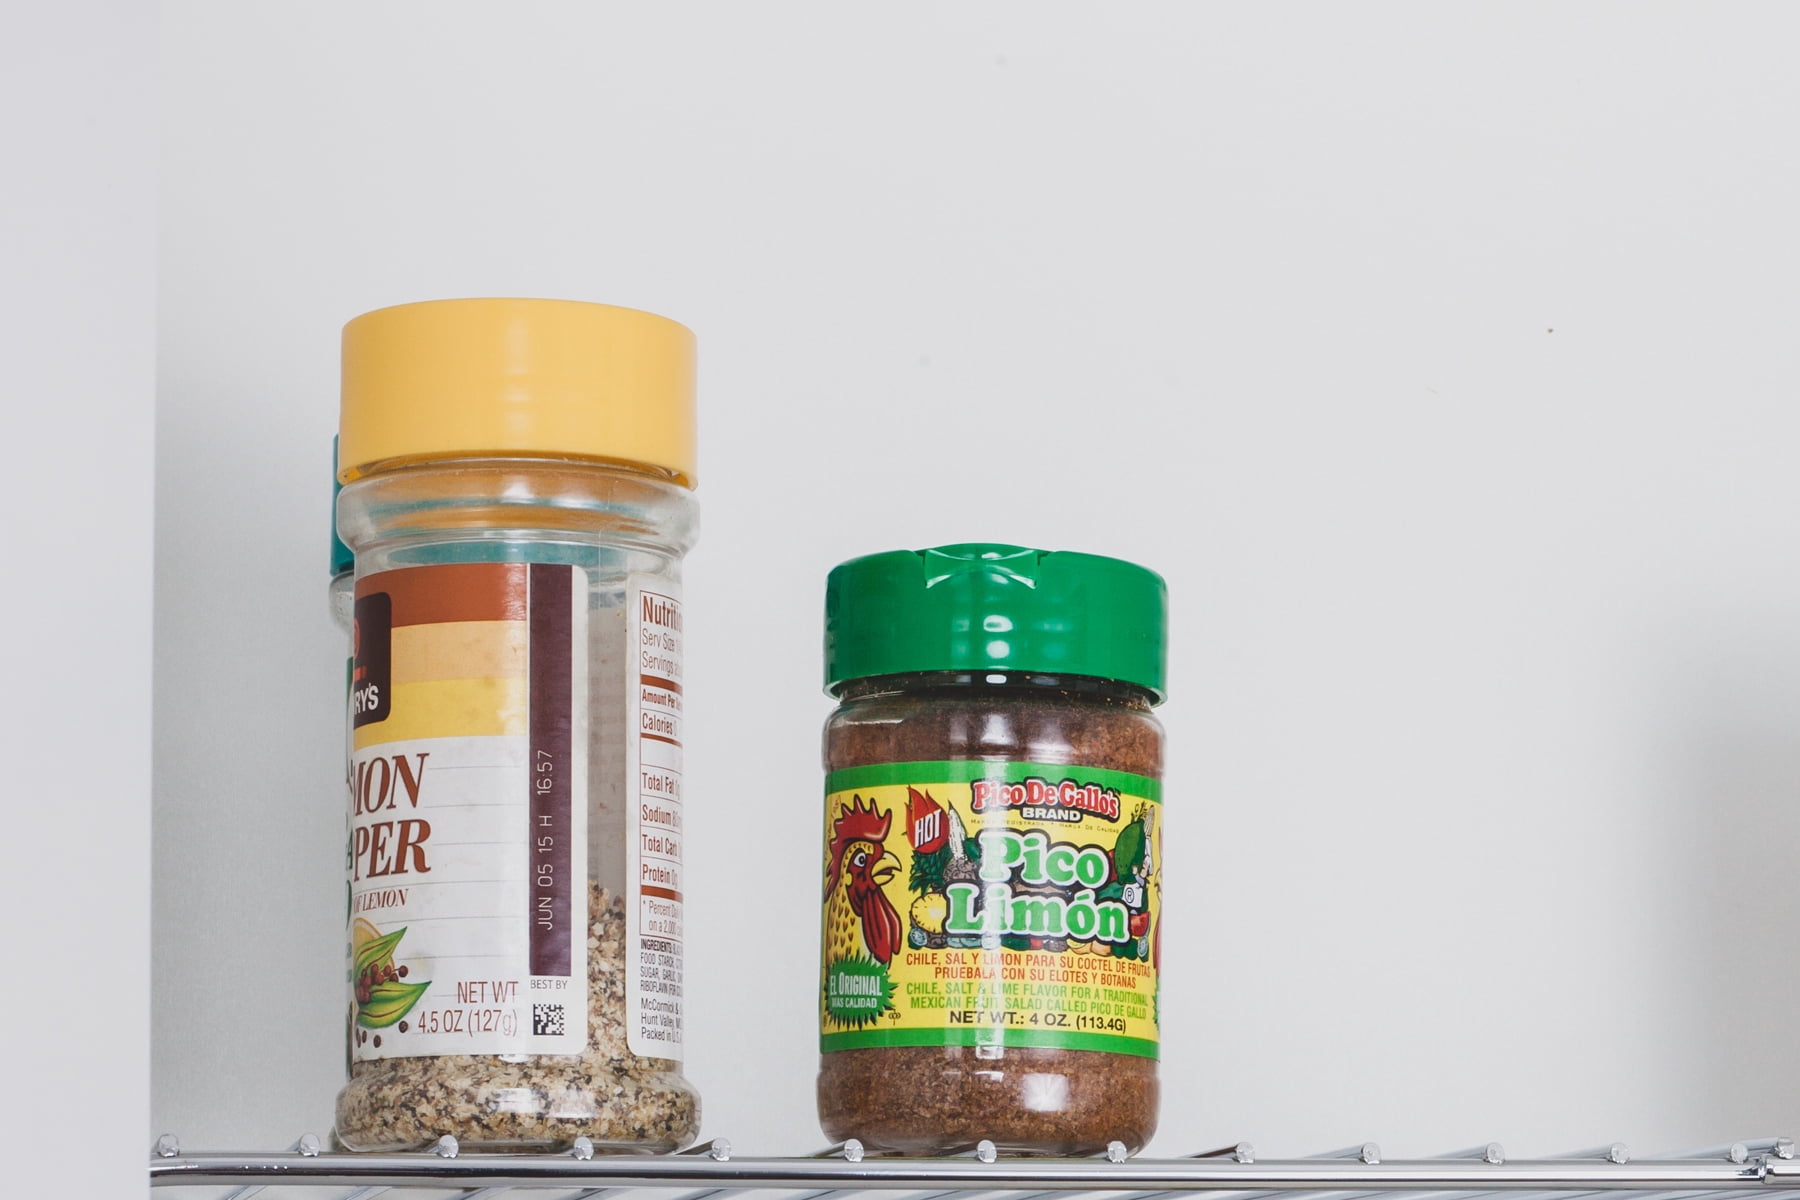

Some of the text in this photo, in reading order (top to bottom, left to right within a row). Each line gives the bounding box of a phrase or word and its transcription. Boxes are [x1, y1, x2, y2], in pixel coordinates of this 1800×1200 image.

[973, 779, 1119, 818] Pico De Gallo's
[1022, 807, 1081, 822] BRAND
[537, 750, 554, 931] JUN 05 15 H 16:57
[914, 808, 942, 849] HOT
[980, 834, 1106, 887] Pico
[363, 888, 409, 911] LEMON
[947, 886, 1129, 941] Limón
[530, 979, 568, 990] BEST BY
[830, 971, 883, 997] EL ORIGINAL
[935, 967, 1137, 989] PRUEBALA CON SU ELOTES Y BOTANAS
[458, 981, 519, 1004] NET WT
[418, 1009, 518, 1036] 4.5 OZ (127g)
[949, 1010, 1127, 1034] NET WT.: 4 OZ. (113.4G)
